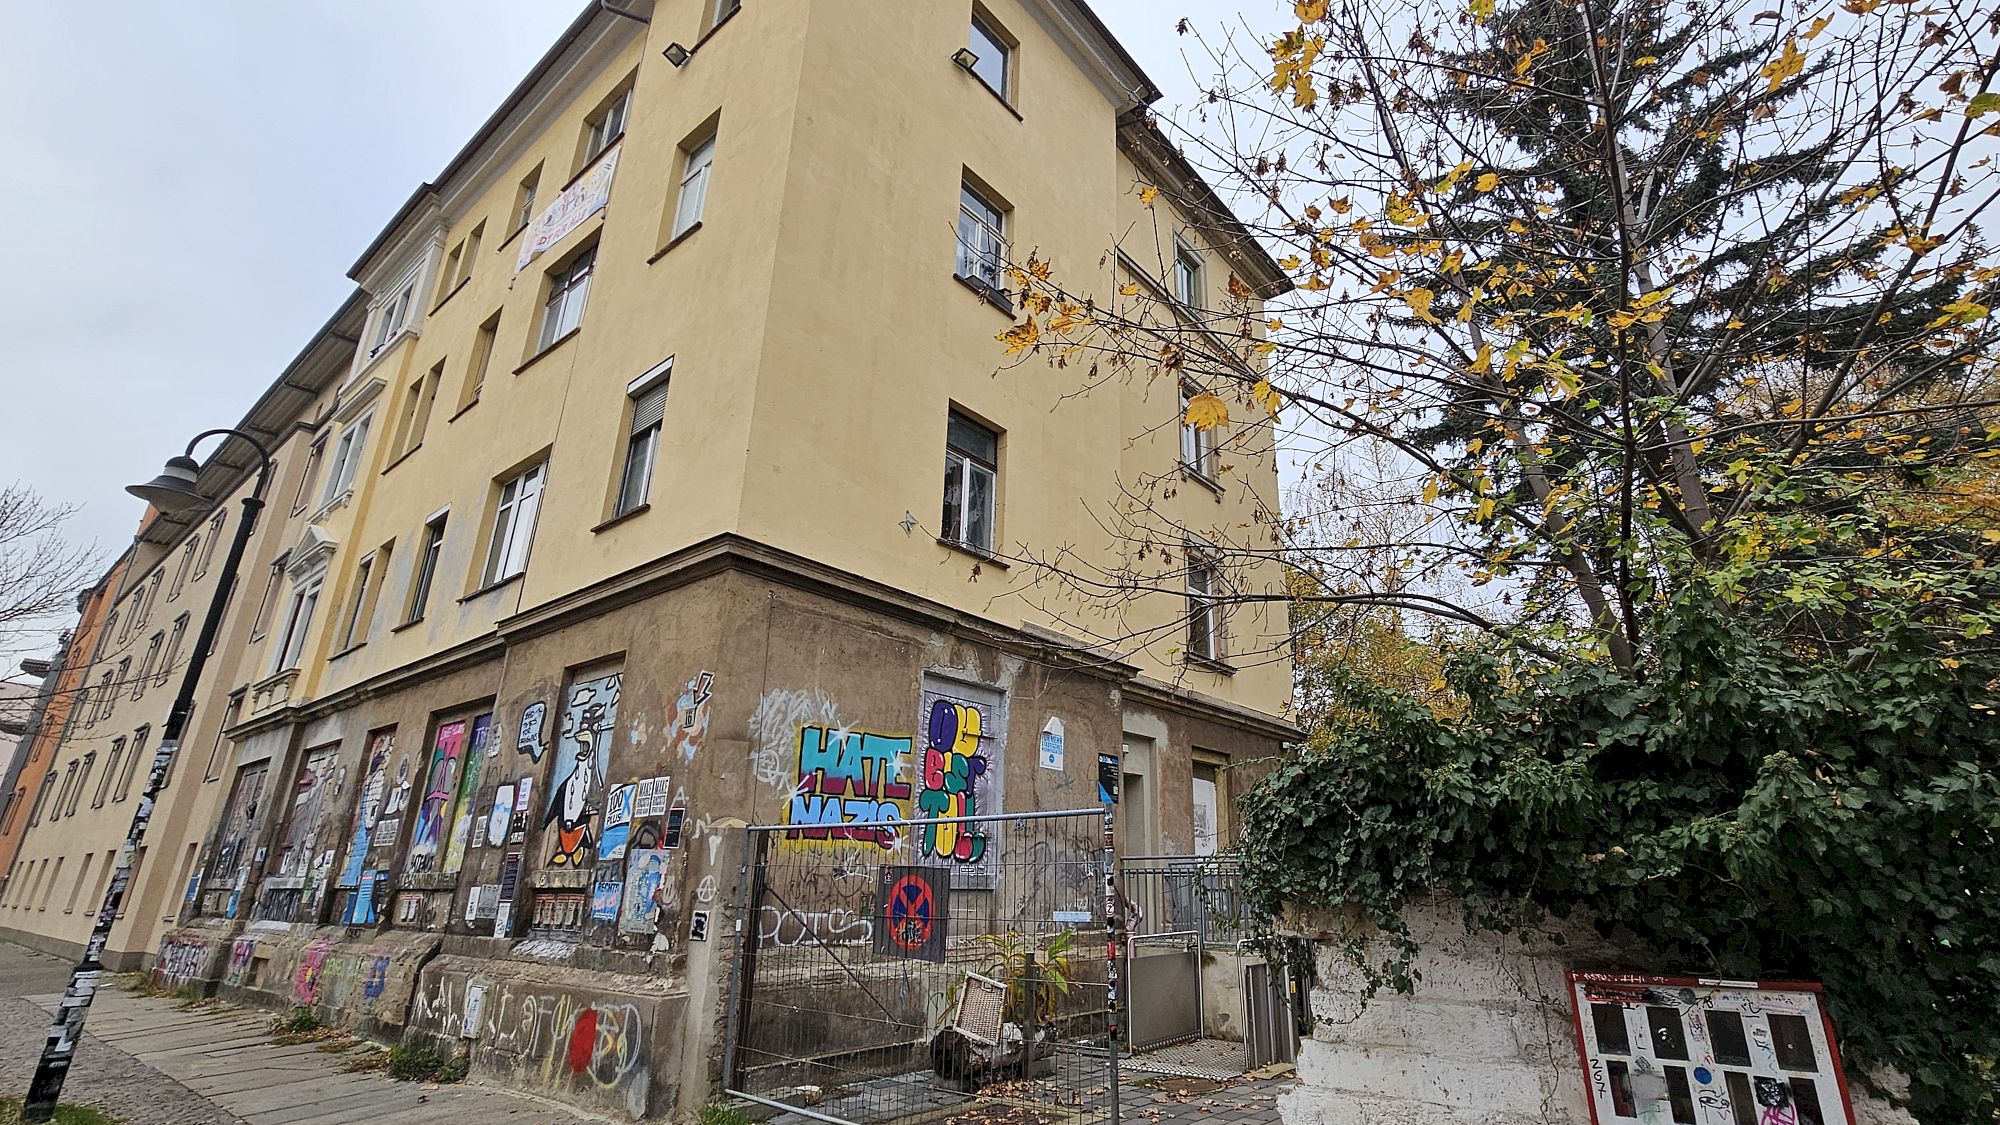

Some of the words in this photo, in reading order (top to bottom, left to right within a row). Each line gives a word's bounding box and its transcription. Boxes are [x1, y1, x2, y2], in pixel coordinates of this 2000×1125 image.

[801, 725, 913, 800] HATE
[606, 813, 622, 826] PLUS
[786, 796, 902, 849] NAZIS
[919, 788, 986, 864] TOLL
